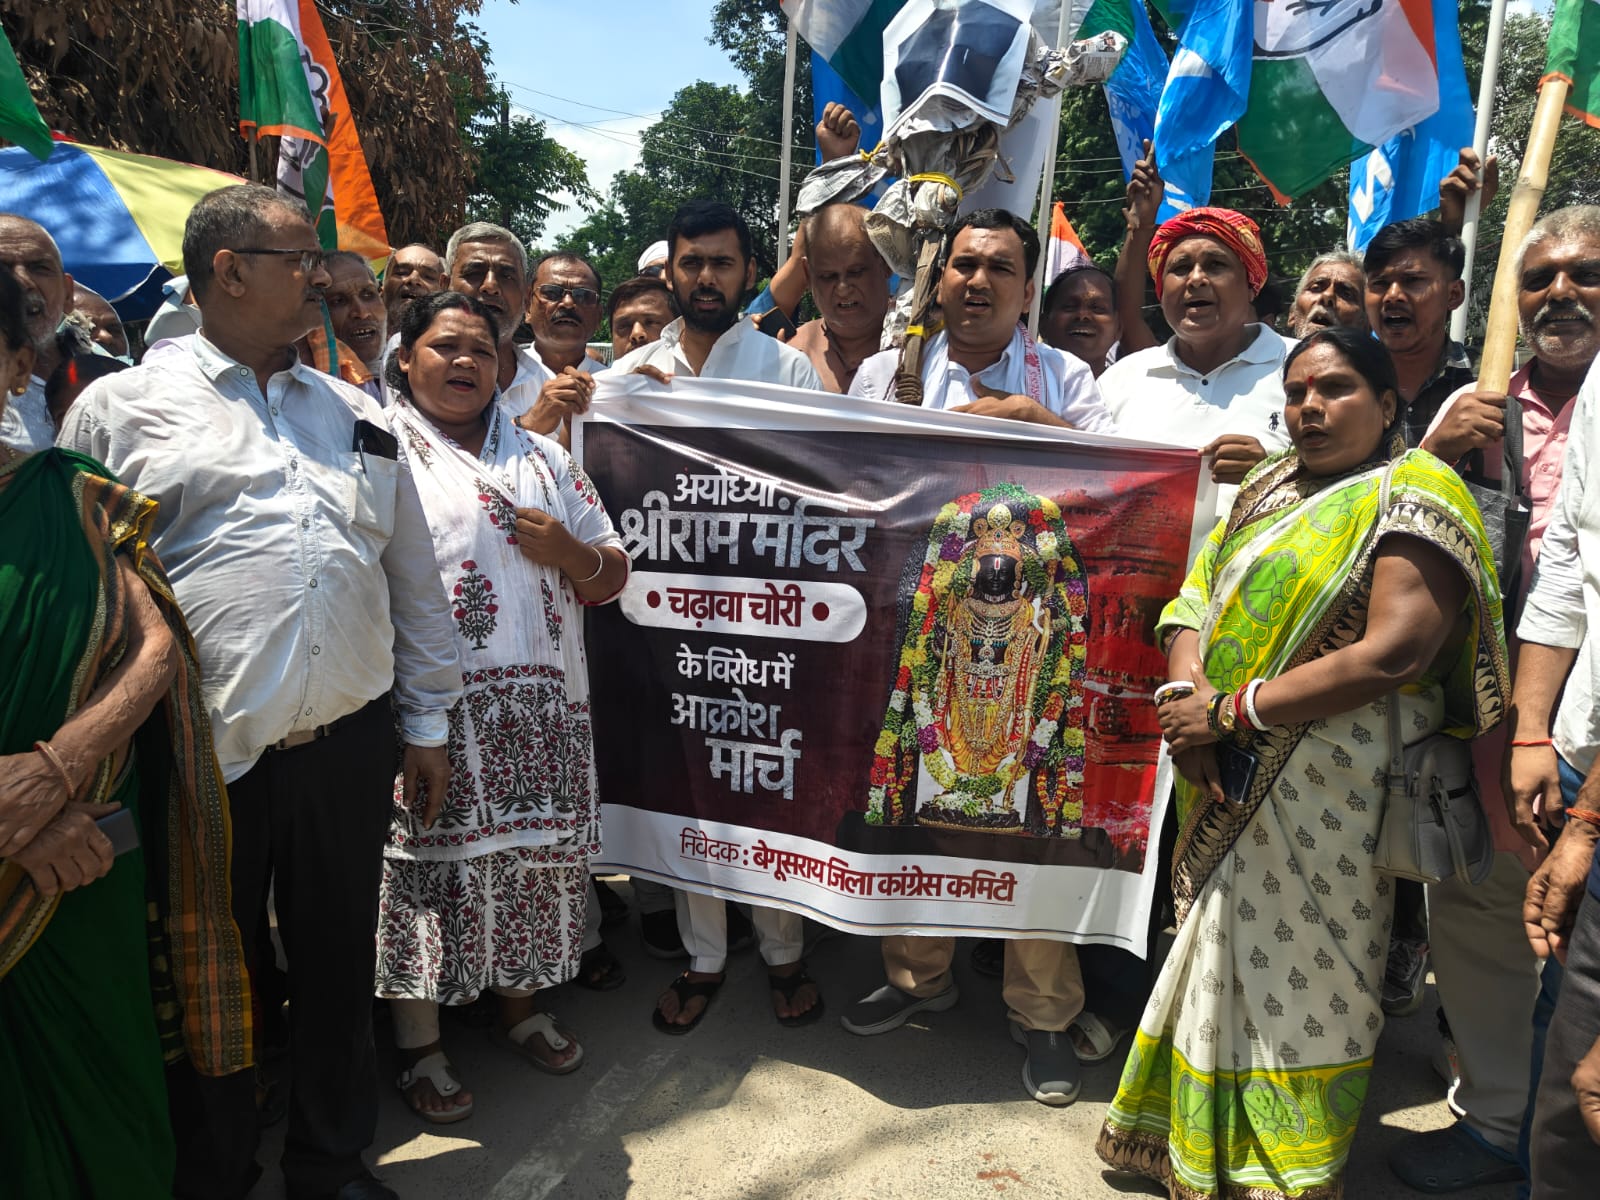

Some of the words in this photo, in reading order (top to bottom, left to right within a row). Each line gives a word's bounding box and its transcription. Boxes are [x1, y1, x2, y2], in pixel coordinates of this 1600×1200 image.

[673, 464, 778, 507] अयोध्या
[620, 490, 749, 565] श्रीराम
[750, 497, 876, 573] मंदिर
[666, 587, 746, 628] चढ़ावा
[747, 582, 805, 627] चोरी
[676, 643, 703, 678] के
[705, 646, 770, 687] विरोध
[770, 652, 796, 690] में
[670, 687, 782, 740] आक्रोश
[705, 728, 802, 801] मार्च
[752, 839, 827, 883] बेगूसराय
[827, 856, 874, 896] जिला
[876, 865, 944, 897] कांग्रेस
[946, 869, 1017, 902] कमिटी
